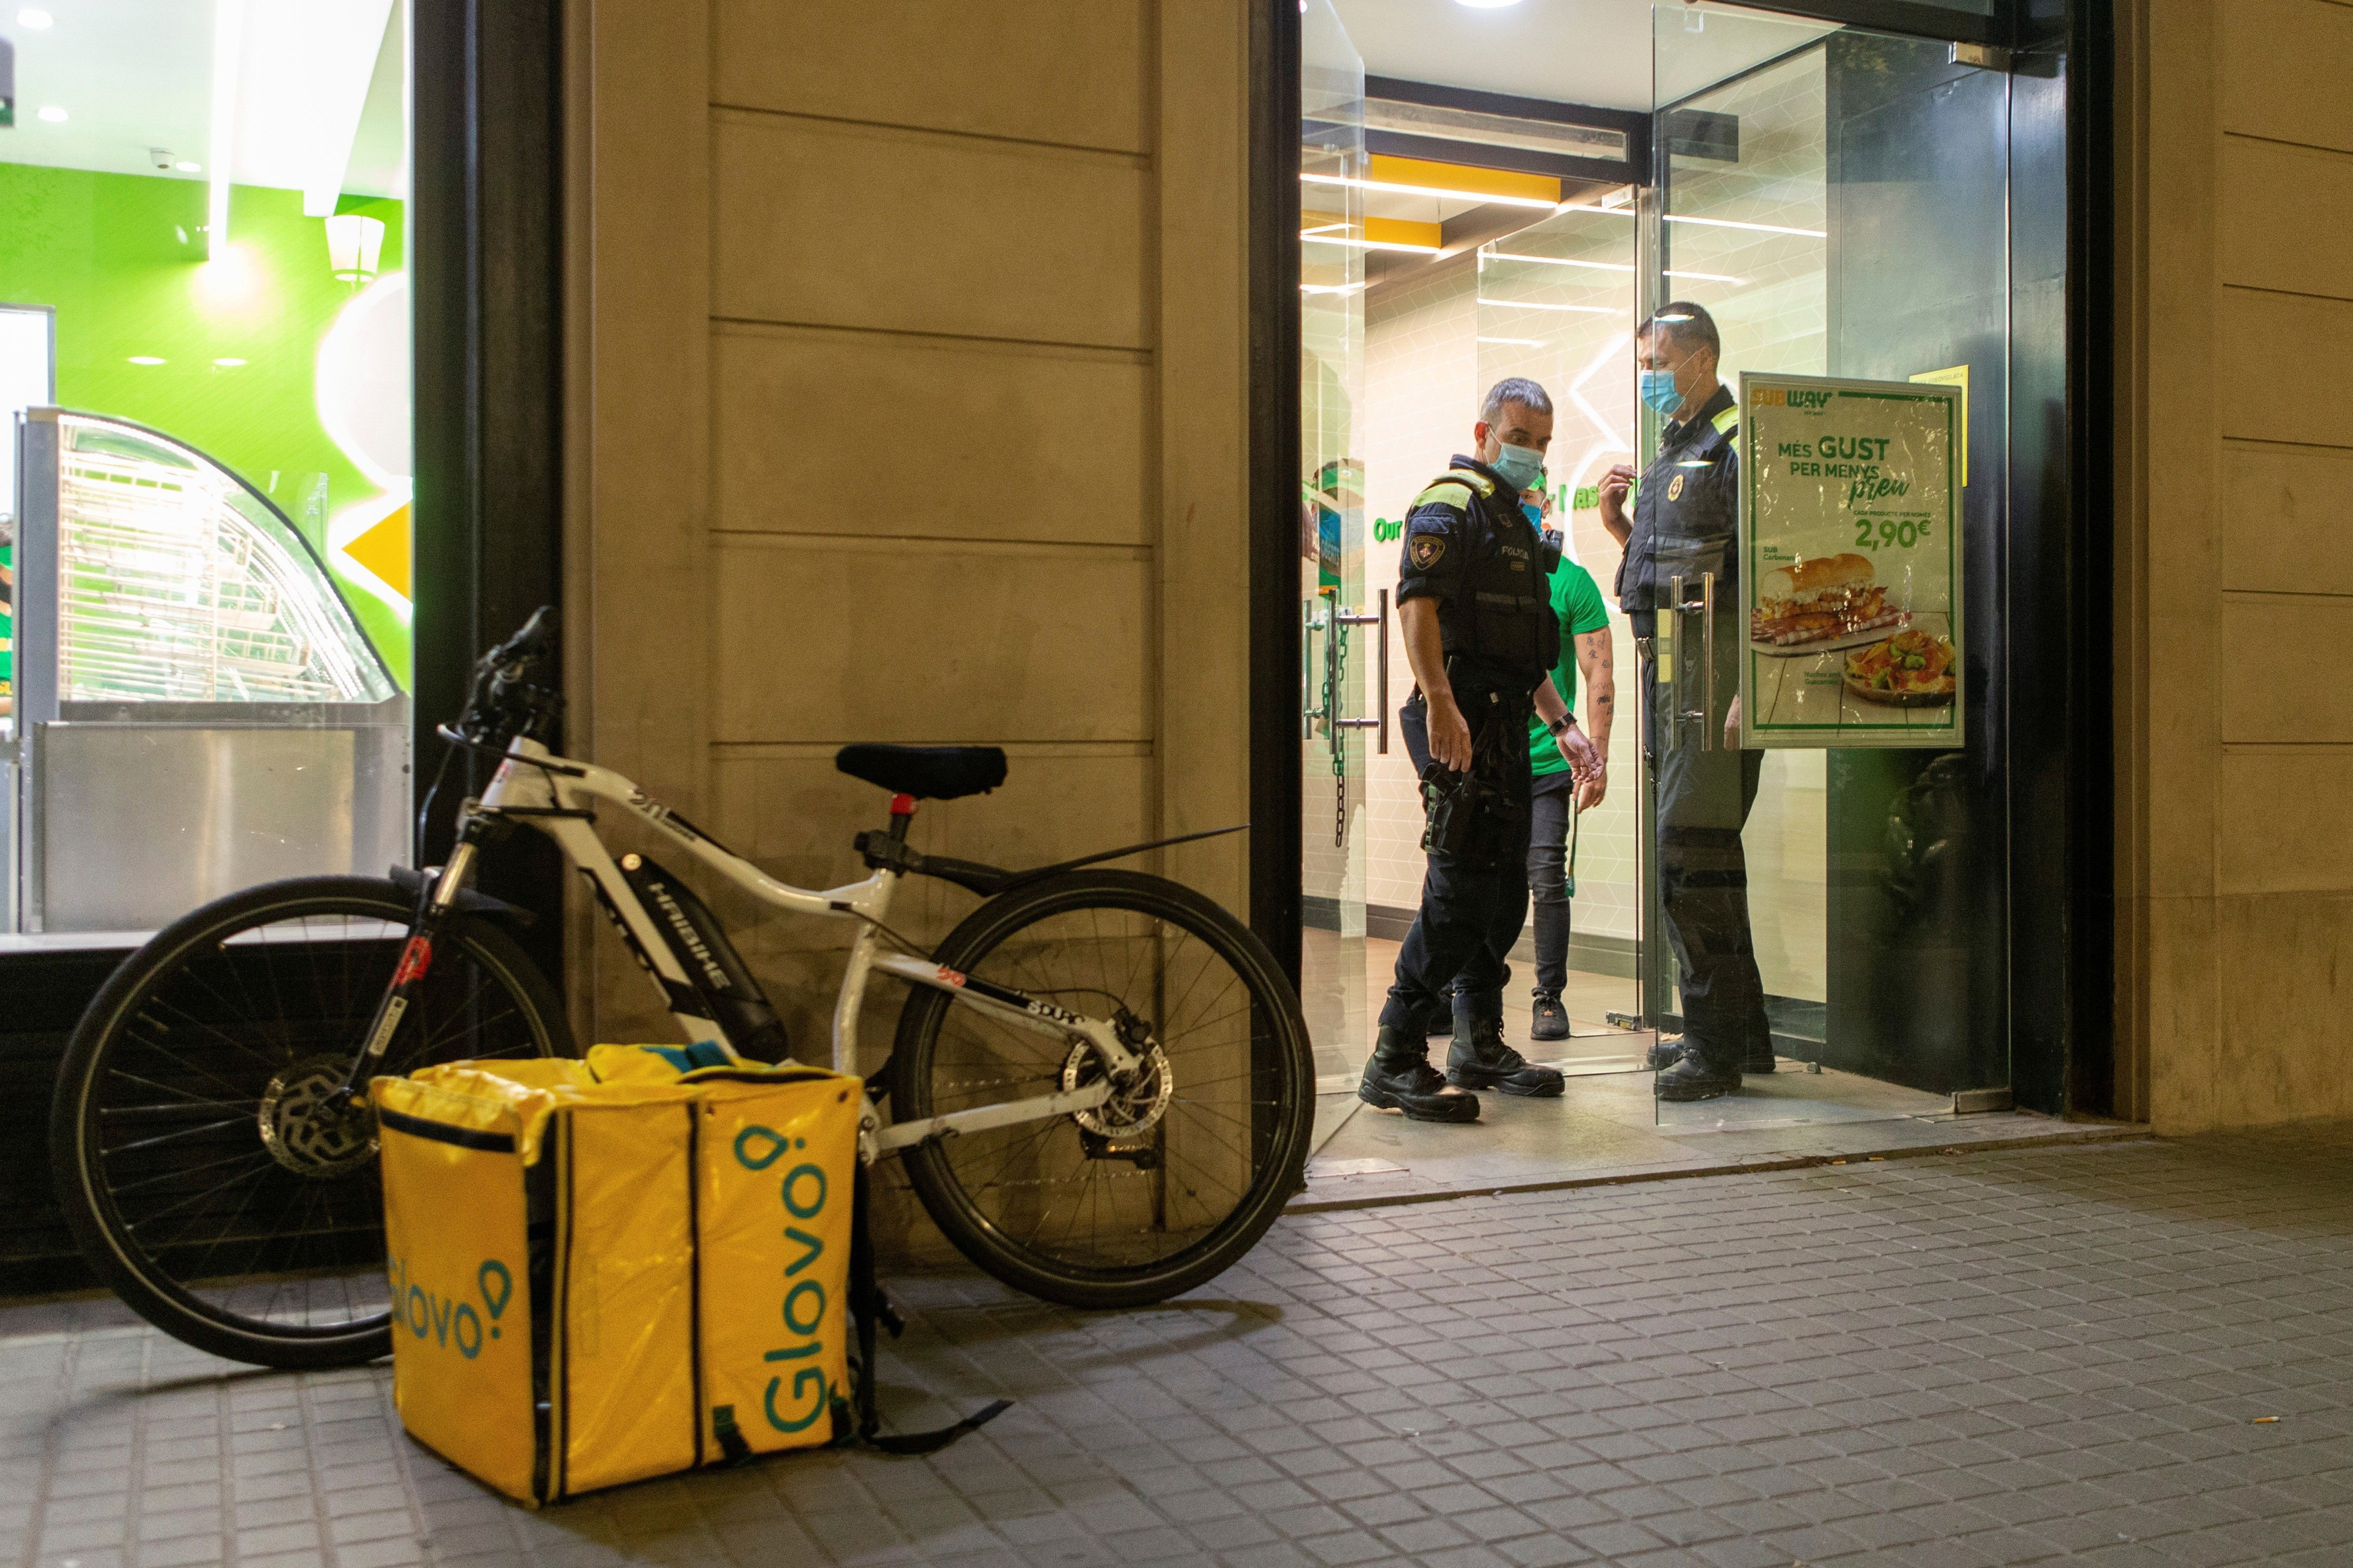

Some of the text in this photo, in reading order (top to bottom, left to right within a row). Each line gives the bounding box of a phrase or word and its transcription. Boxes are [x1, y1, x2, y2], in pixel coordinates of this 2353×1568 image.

[1749, 389, 1833, 408] SUBWAY
[1778, 436, 1890, 461] MÉS GUST
[1790, 462, 1880, 479] PER MENYS
[1374, 518, 1403, 542] Our
[1855, 519, 1932, 552] 2,90€
[764, 1162, 828, 1433] Glovo
